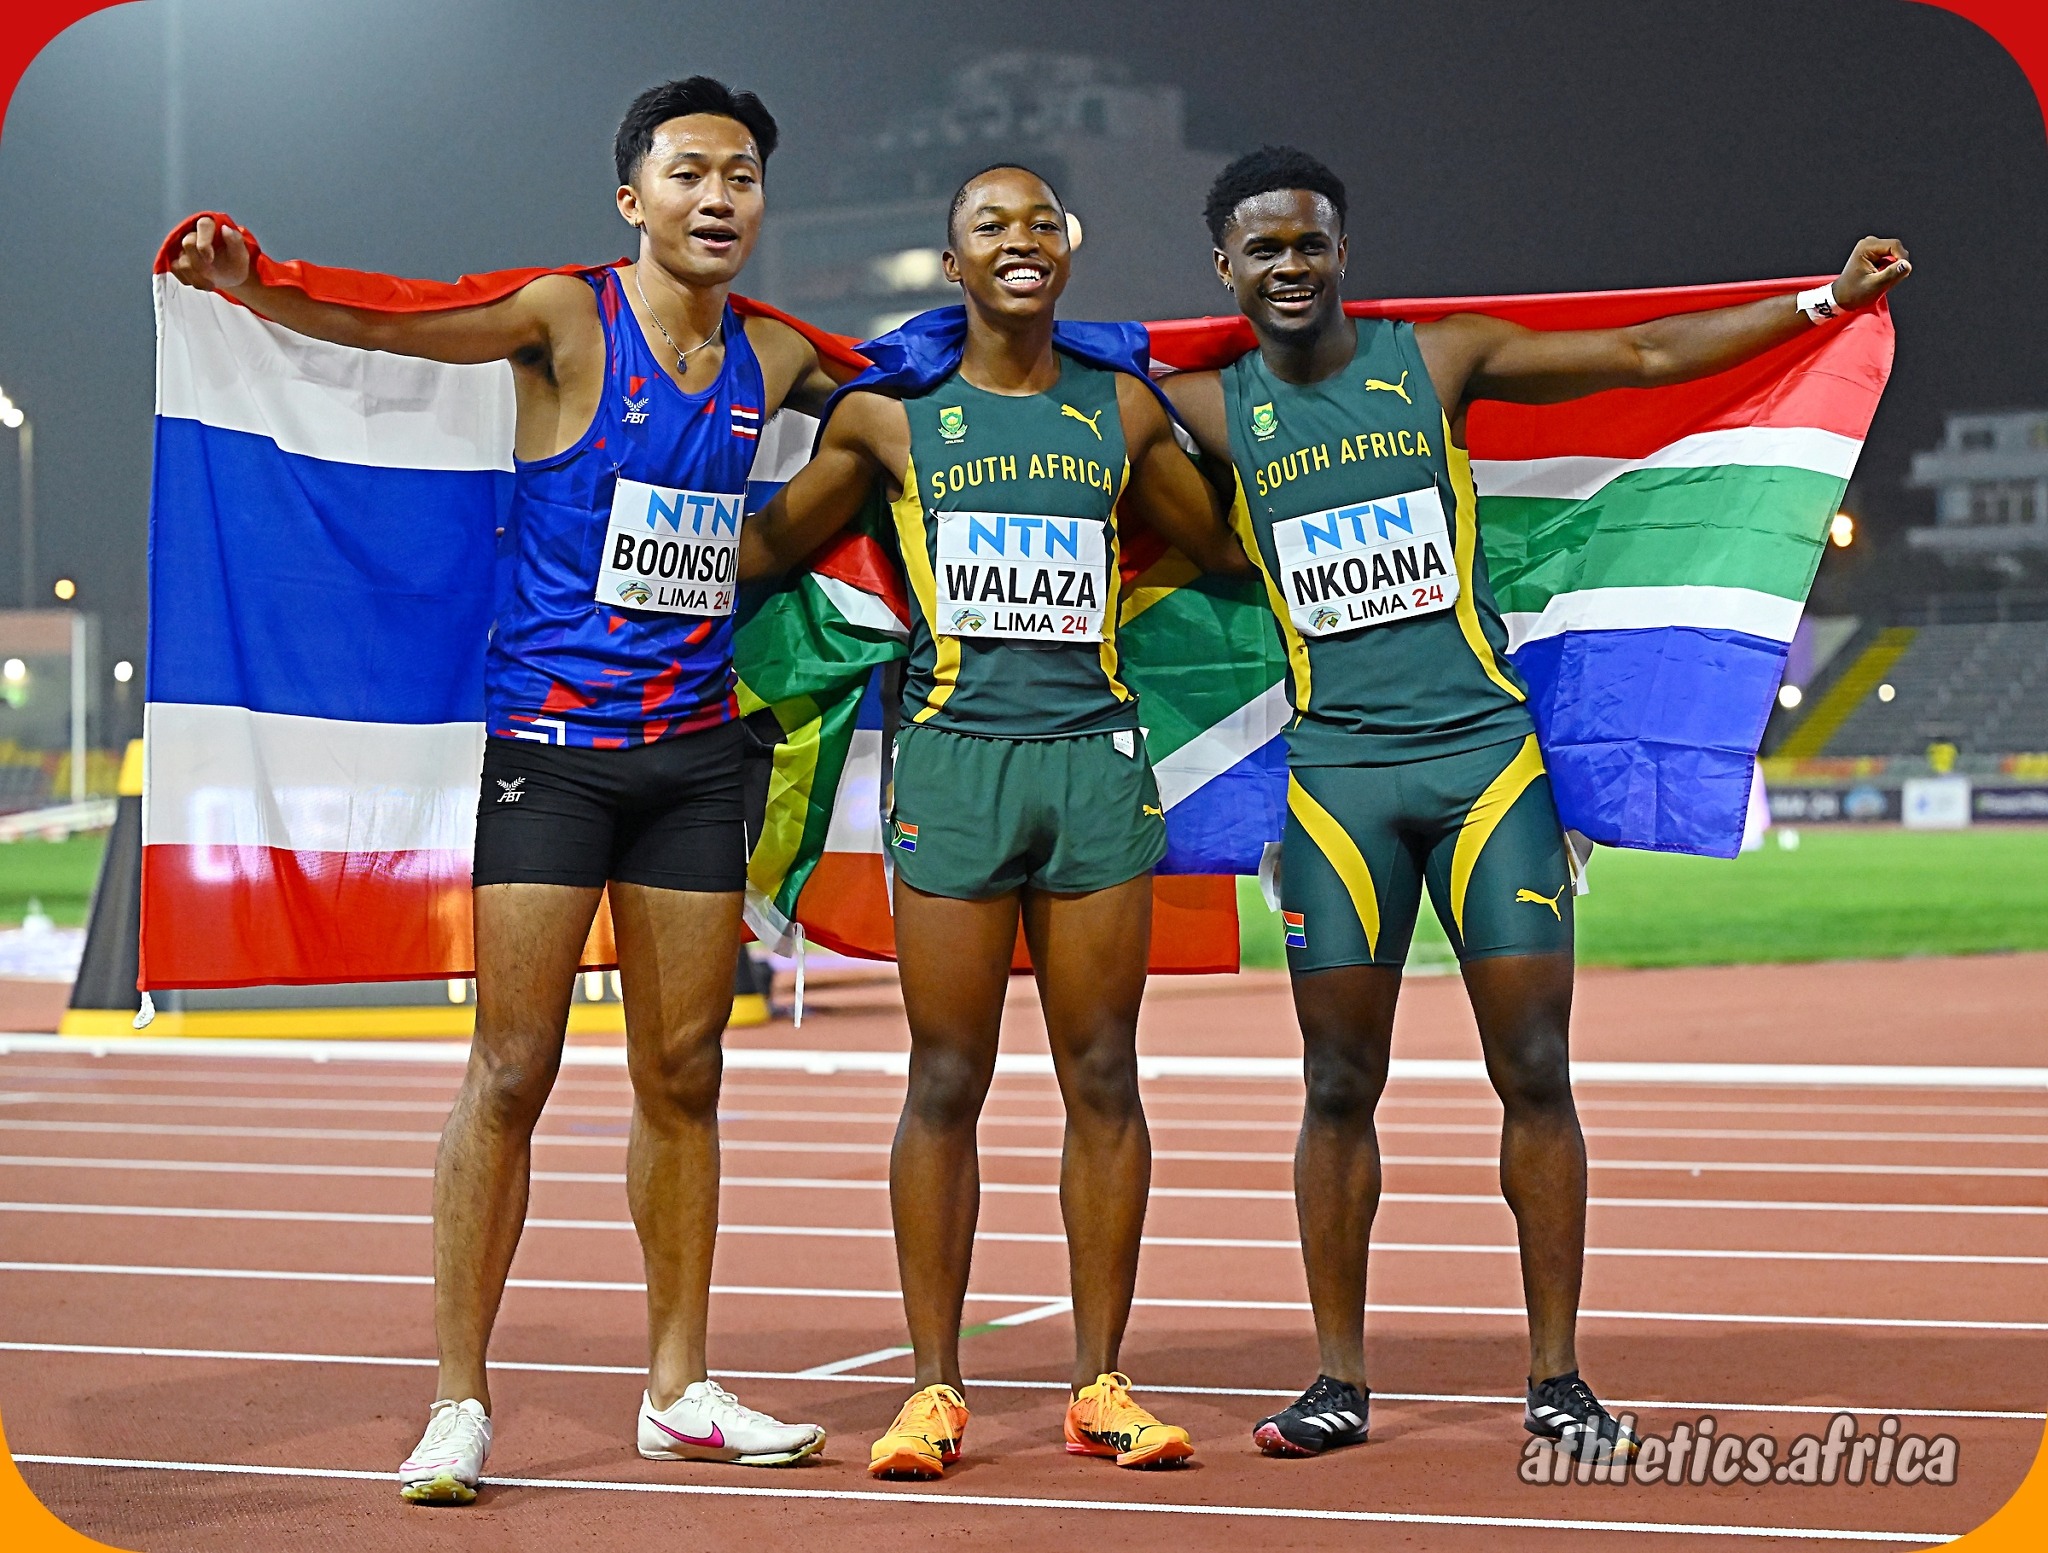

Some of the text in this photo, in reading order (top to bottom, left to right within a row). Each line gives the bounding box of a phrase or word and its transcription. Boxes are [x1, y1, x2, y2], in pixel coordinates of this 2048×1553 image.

[931, 453, 1113, 499] SOUTH AFRICA
[1255, 429, 1432, 497] SOUTH AFRICA
[646, 489, 740, 537] NTN
[1300, 496, 1414, 556] NTN
[612, 533, 739, 583] BOONSON
[968, 515, 1079, 561] NTN
[945, 564, 1097, 609] WALAZA
[1292, 541, 1448, 606] NKOANA
[657, 586, 731, 610] LIMA 24
[1347, 584, 1444, 622] LIMA 24
[994, 611, 1088, 635] LIMA 24
